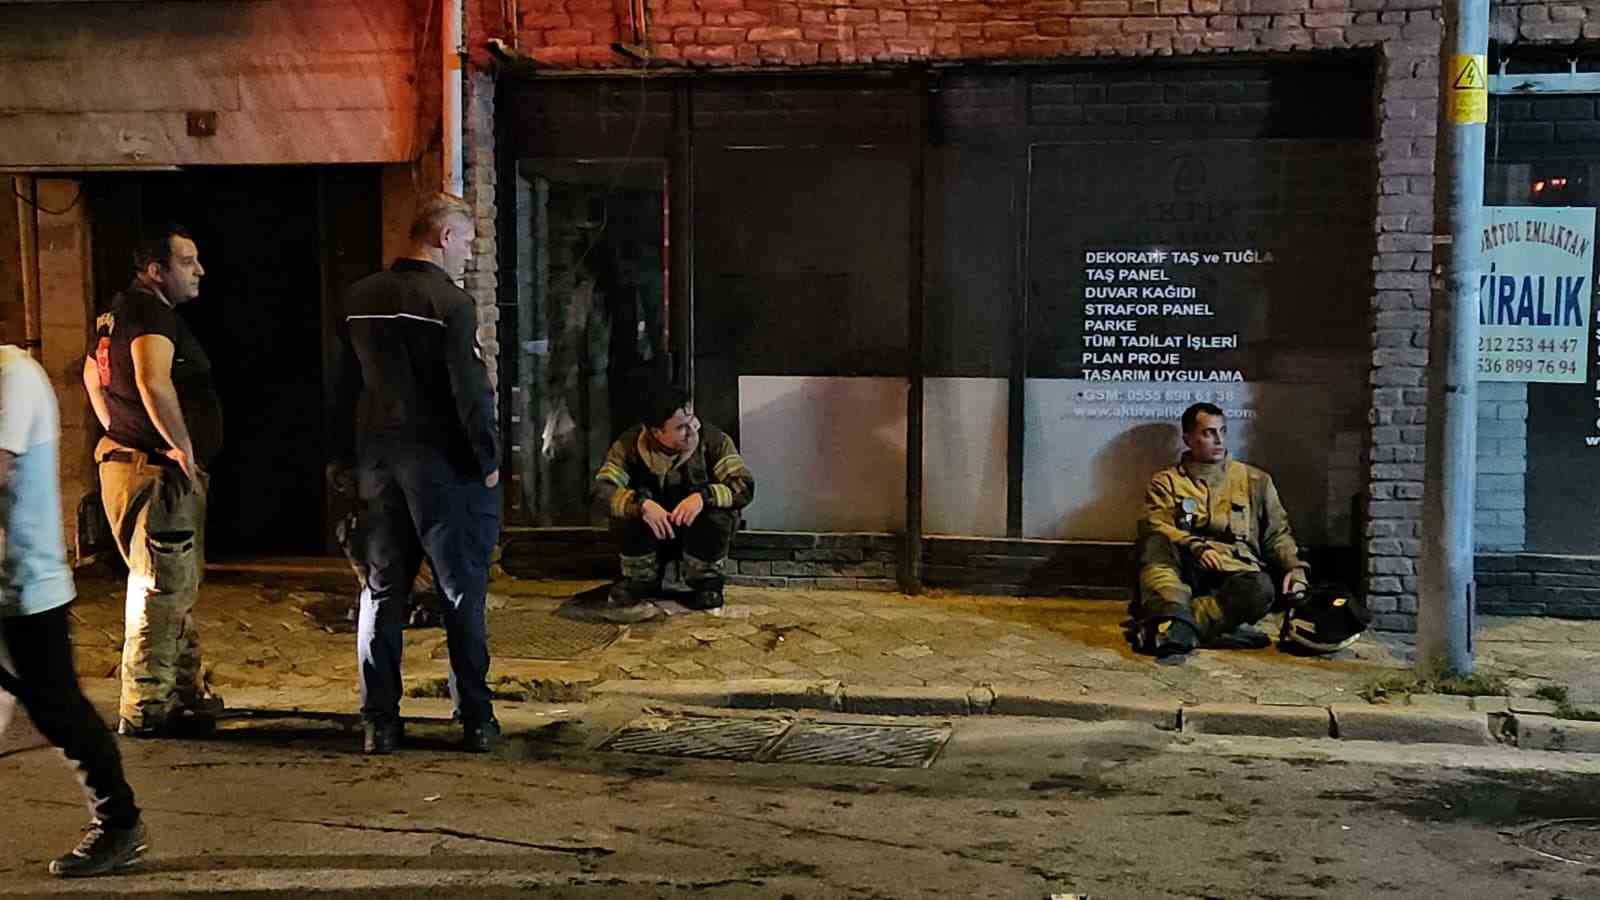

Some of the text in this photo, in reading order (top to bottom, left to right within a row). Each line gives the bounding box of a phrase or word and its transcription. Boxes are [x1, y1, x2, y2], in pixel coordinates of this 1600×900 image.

[1480, 219, 1590, 257] RTYOL EMLAKTAN
[1085, 249, 1273, 266] DEKORATİF TAŞ ve TUĞLA
[1086, 269, 1170, 283] TAŞ PANEL
[1085, 285, 1196, 299] DUVAR KAĞIDI
[1084, 304, 1214, 316] STRAFOR PANEL
[1085, 320, 1137, 332] PARKE
[1083, 334, 1238, 351] TÜM TADİLAT İŞLERİ
[1507, 337, 1534, 352] 253
[1537, 337, 1555, 353] 44
[1559, 338, 1578, 353] 47
[1083, 353, 1180, 365] PLAN PROJE
[1505, 359, 1533, 374] 899
[1537, 360, 1555, 374] 76
[1559, 359, 1577, 375] 94
[1083, 369, 1244, 383] TASARIM UYGULAMA
[1084, 389, 1124, 401] GSM:
